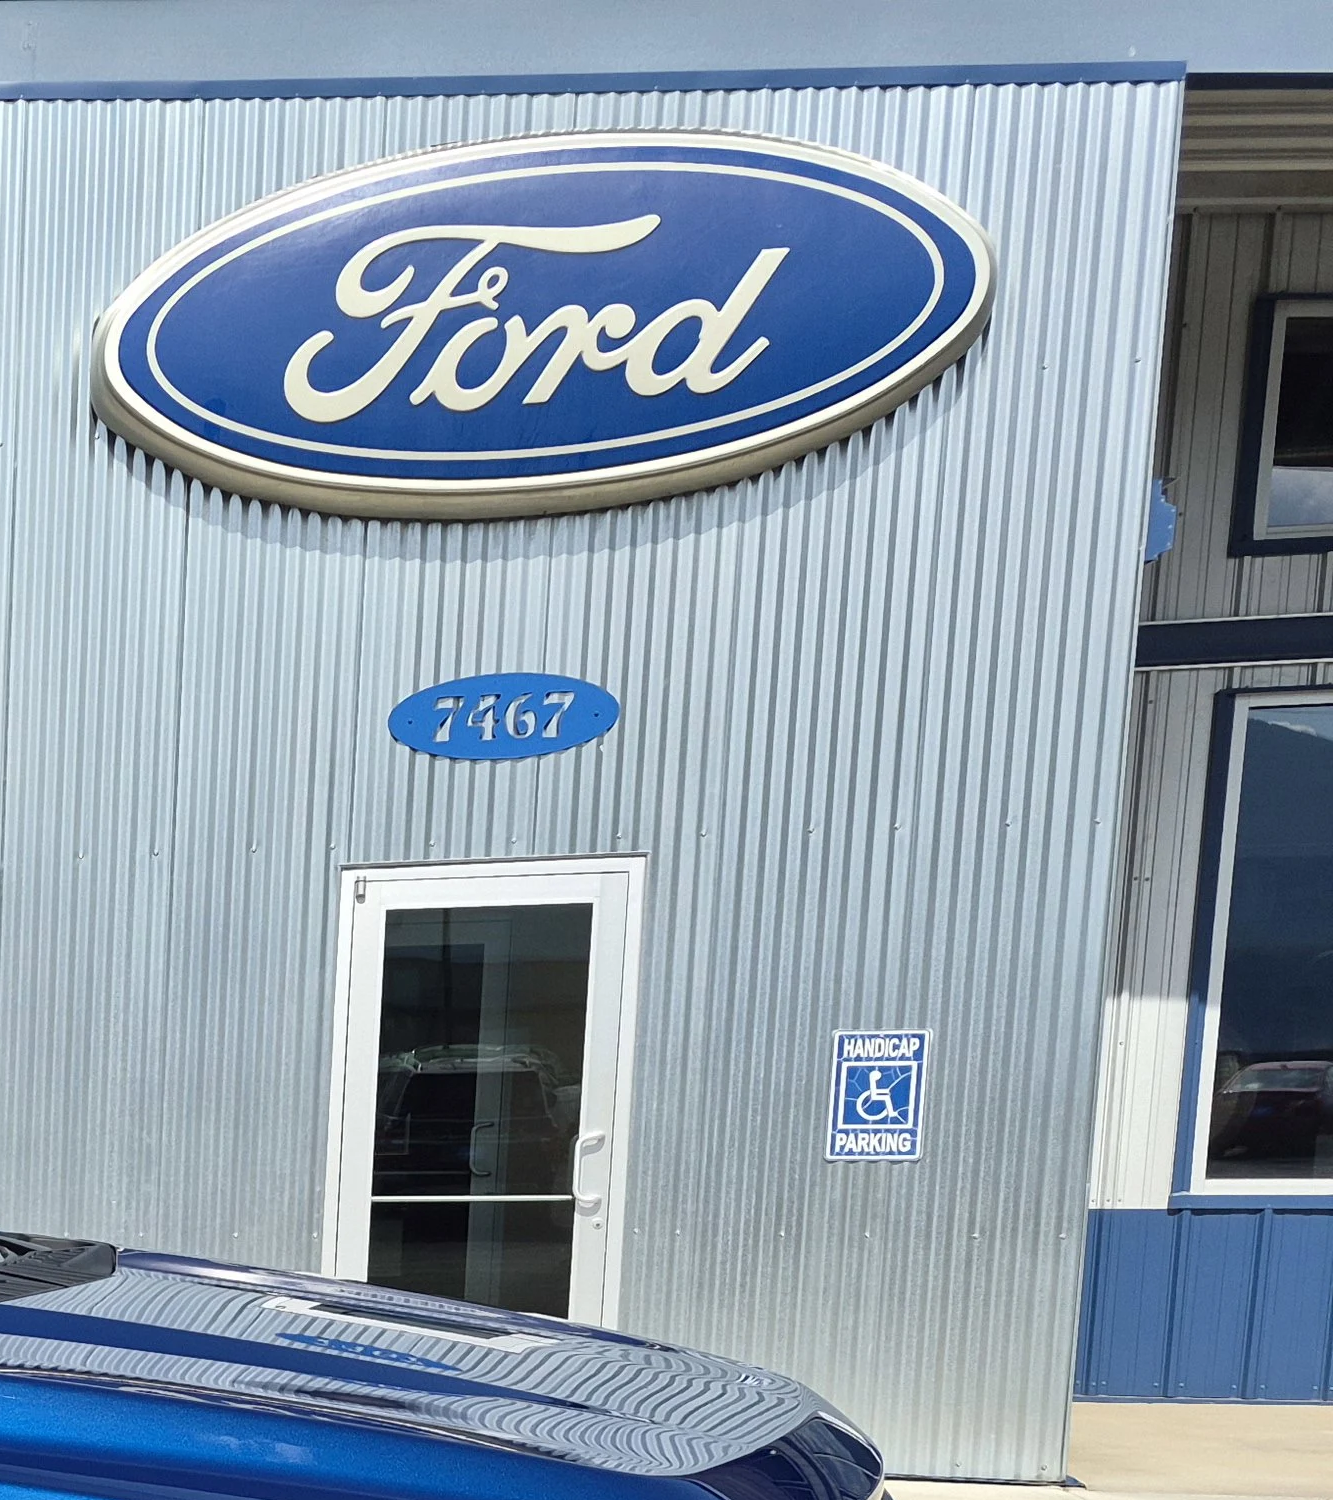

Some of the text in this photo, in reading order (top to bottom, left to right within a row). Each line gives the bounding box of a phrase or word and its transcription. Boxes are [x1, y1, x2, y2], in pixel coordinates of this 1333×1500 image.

[284, 213, 790, 423] Ford
[433, 691, 576, 743] 7467
[843, 1037, 920, 1058] HANDICAP
[834, 1132, 912, 1153] PARKING
